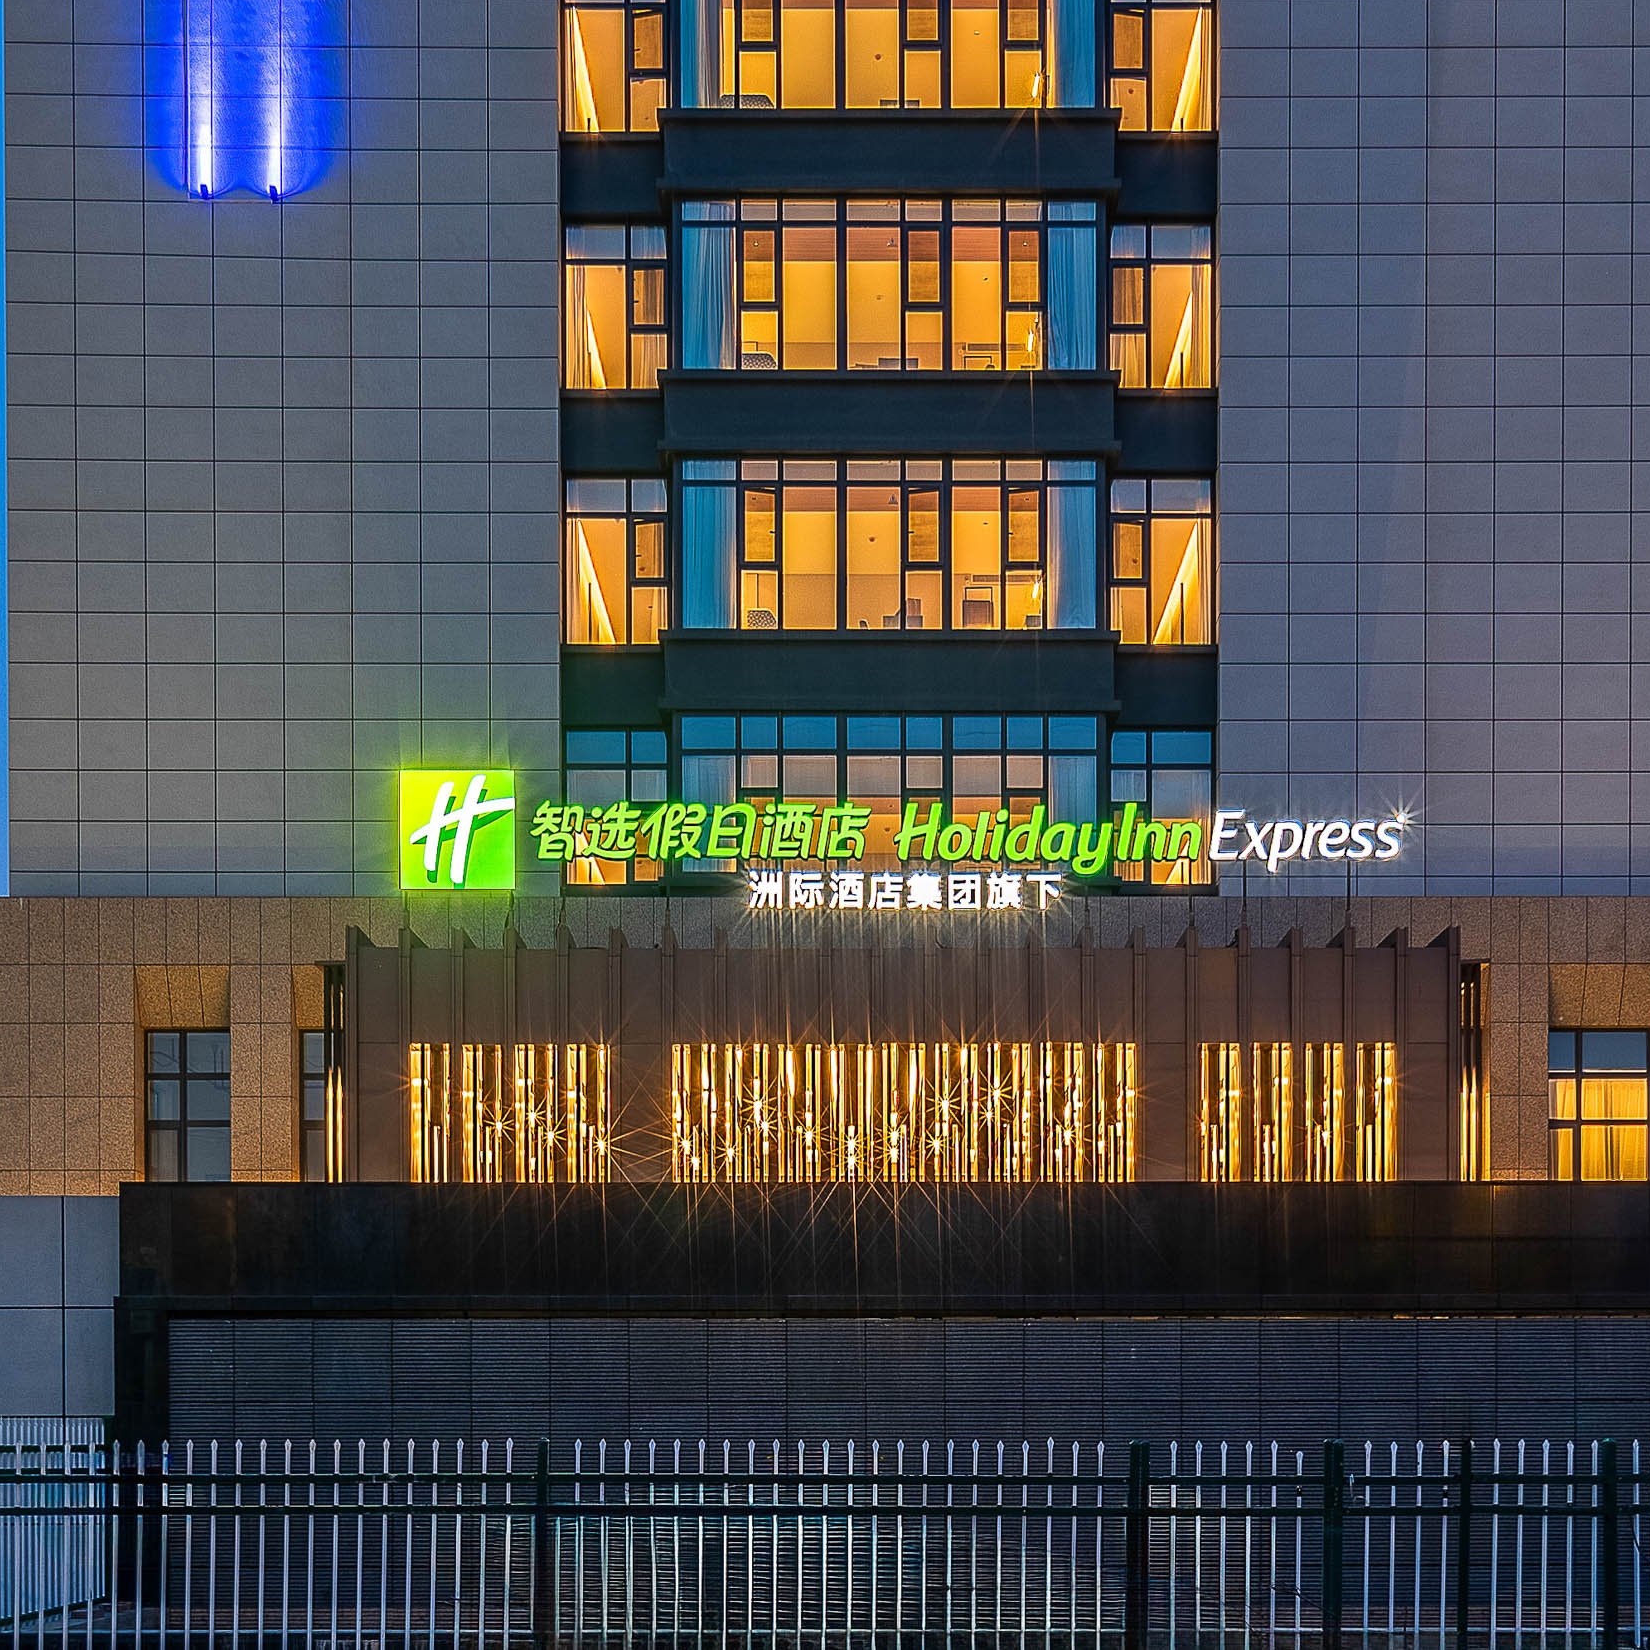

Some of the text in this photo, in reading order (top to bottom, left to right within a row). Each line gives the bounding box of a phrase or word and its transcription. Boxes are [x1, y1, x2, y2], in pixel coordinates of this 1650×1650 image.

[530, 800, 872, 861] 智选假日酒店
[1209, 808, 1406, 874] Express
[749, 871, 1062, 910] 洲际酒店集团旗下
